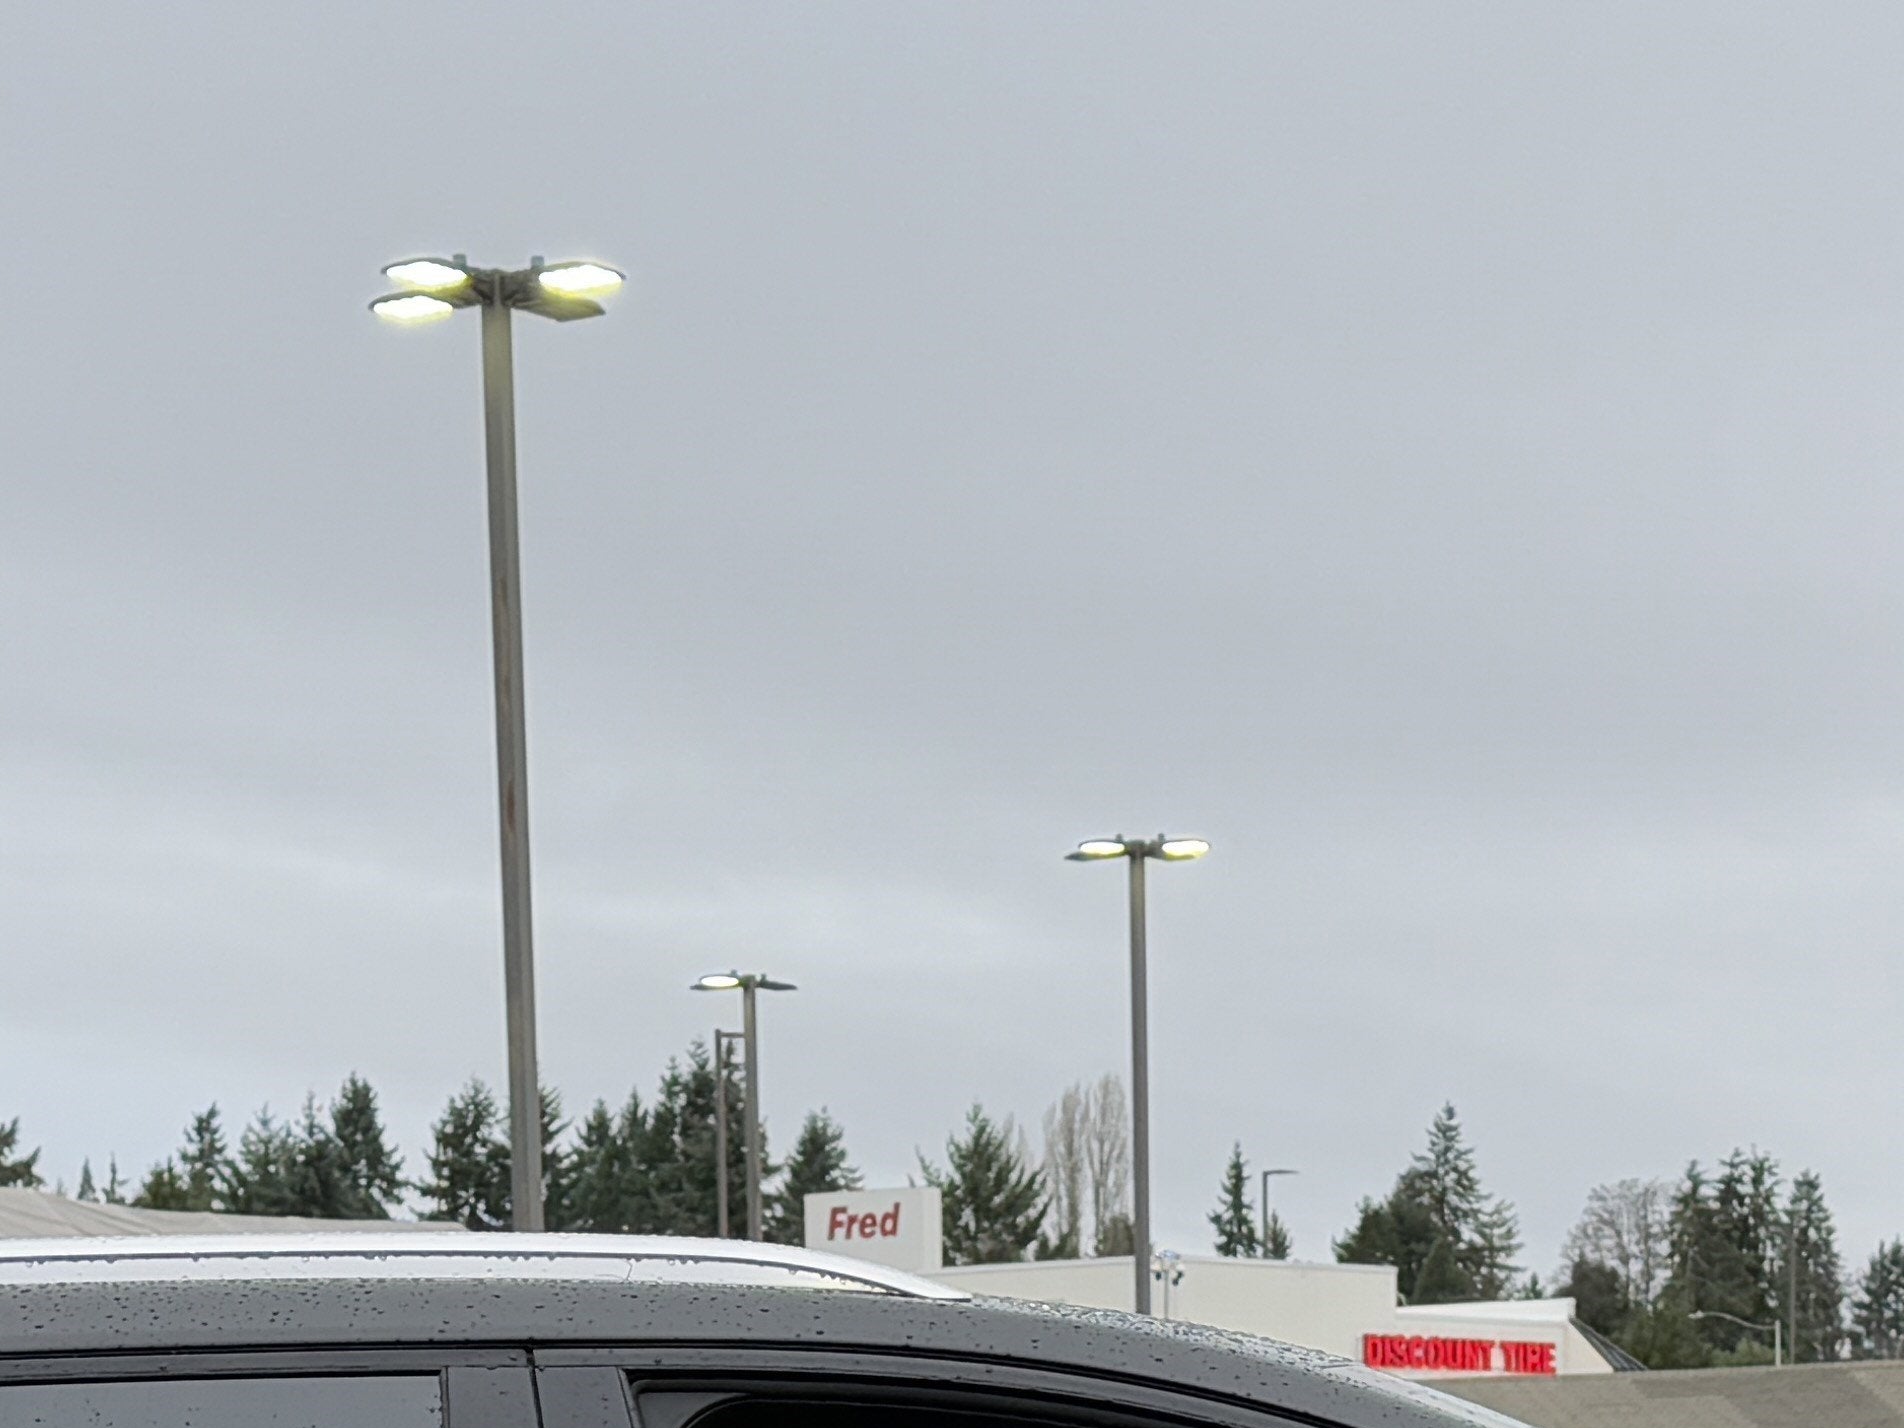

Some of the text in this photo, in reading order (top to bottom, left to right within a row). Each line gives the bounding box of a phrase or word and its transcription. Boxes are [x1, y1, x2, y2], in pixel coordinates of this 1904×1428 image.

[827, 1202, 900, 1241] Fred
[1364, 1333, 1557, 1375] DISCOUNT TIRE
